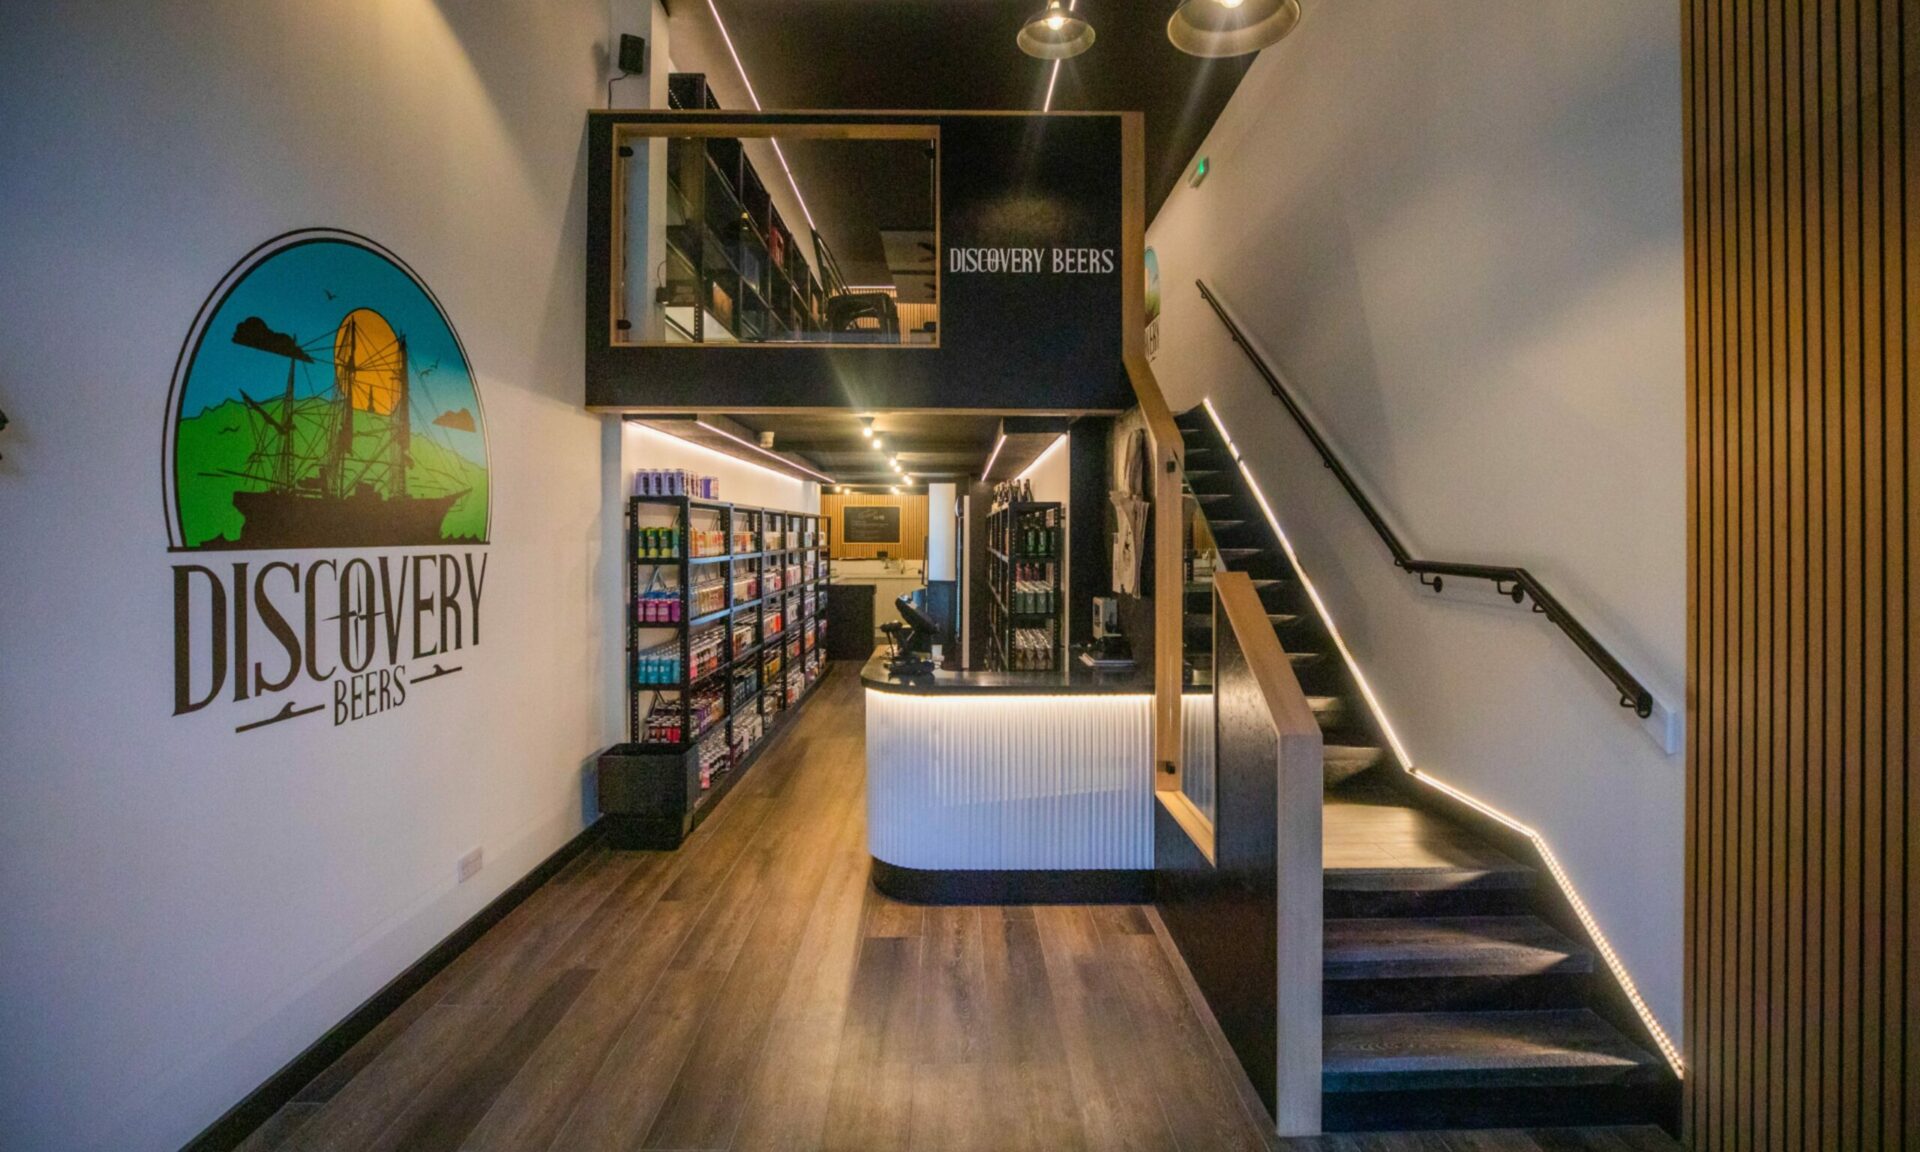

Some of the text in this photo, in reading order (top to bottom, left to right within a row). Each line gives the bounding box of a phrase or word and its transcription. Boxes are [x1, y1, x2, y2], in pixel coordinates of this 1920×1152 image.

[949, 248, 1114, 273] DISCOVERY BEERS
[171, 552, 488, 717] DISCOVERY
[333, 664, 407, 727] BEERS
